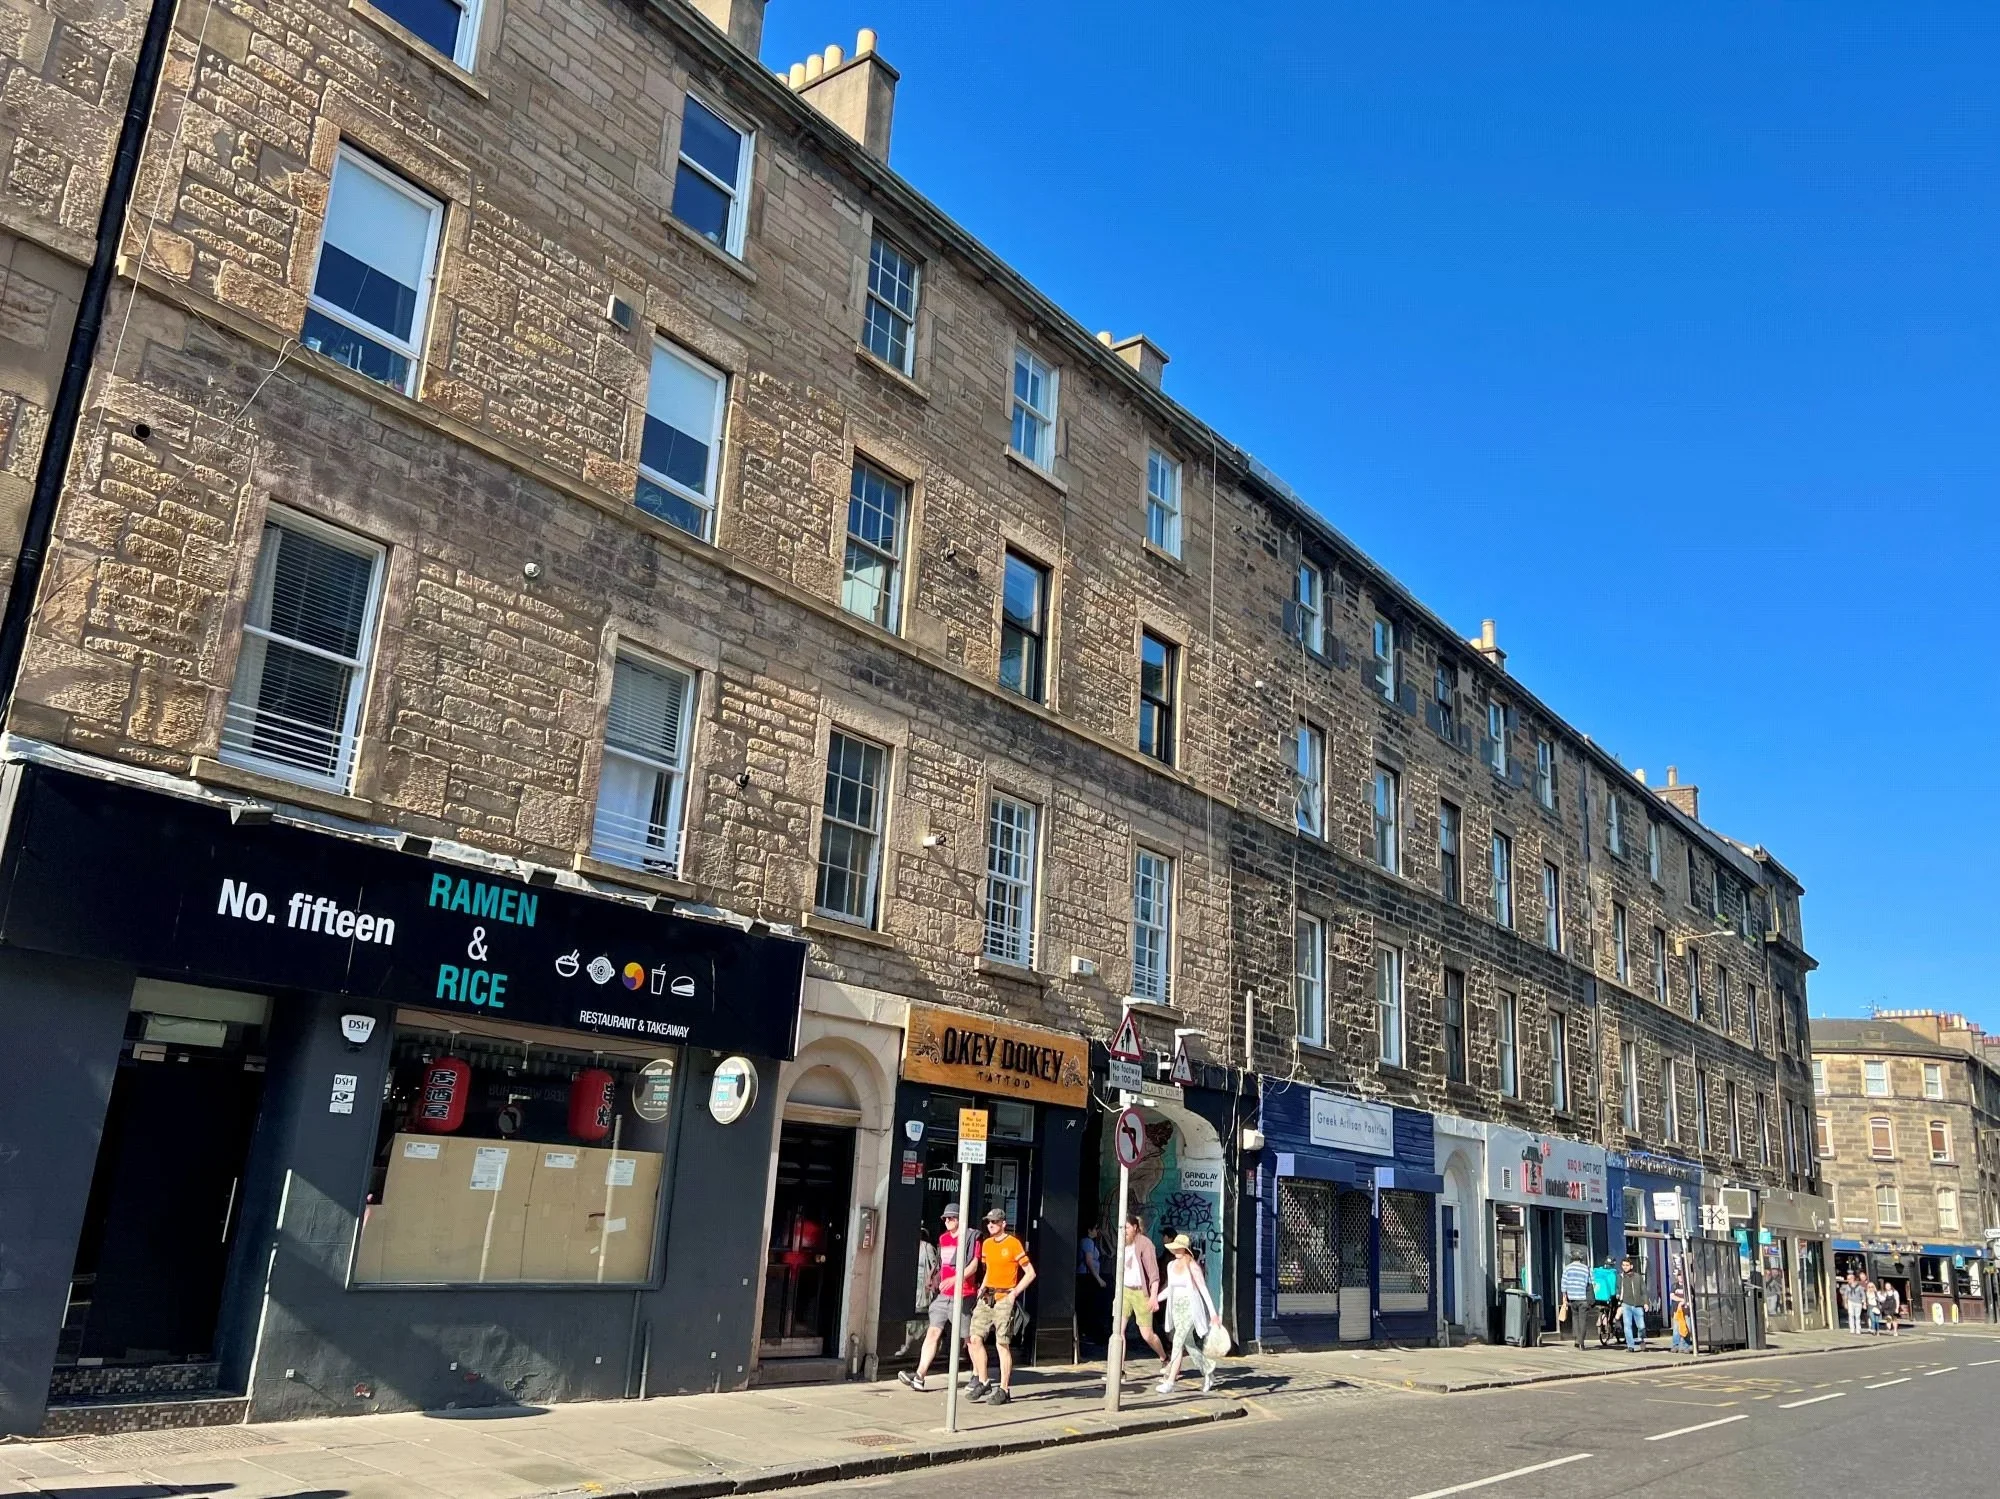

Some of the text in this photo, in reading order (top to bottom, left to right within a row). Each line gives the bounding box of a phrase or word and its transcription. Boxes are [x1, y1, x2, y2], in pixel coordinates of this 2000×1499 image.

[428, 872, 539, 927] RAMEN
[217, 878, 396, 946] No. fifteen
[467, 926, 488, 961] &
[436, 963, 508, 1008] RICE
[579, 1010, 690, 1038] RESTAURANT & TAKEAWAY
[941, 1027, 1065, 1083] OKEY DOKEY
[1112, 1062, 1120, 1072] No
[977, 1071, 1031, 1089] TATTOO
[1121, 1075, 1132, 1084] 100
[421, 1068, 458, 1120] 居酒屋
[1317, 1112, 1387, 1136] Greek Artisan Pastries
[1184, 1171, 1218, 1180] GRINDLAY
[1582, 1161, 1592, 1174] HOT
[1593, 1163, 1602, 1176] POT
[927, 1177, 959, 1192] TATTOOS
[1189, 1180, 1214, 1188] COURT
